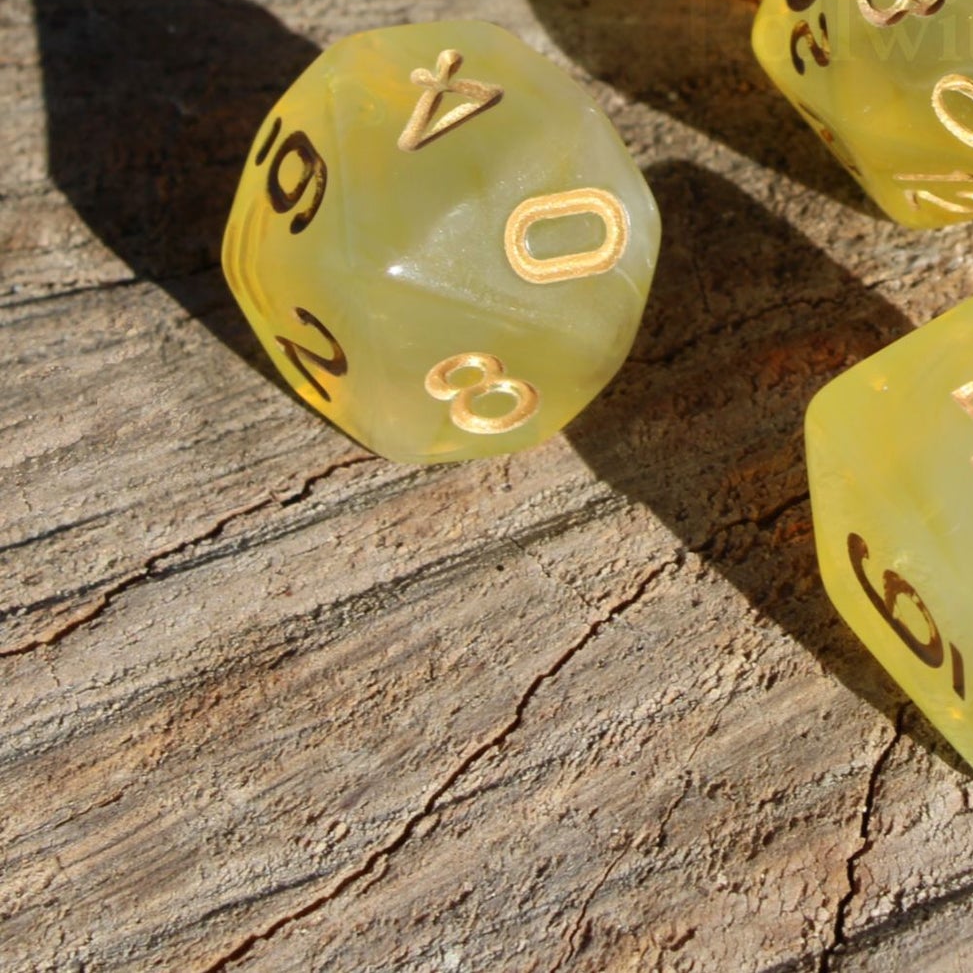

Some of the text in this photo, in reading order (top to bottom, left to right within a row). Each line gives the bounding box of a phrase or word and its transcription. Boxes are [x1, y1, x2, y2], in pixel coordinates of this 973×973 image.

[397, 48, 504, 152] 4
[504, 187, 628, 285] 0
[275, 306, 348, 403] 2
[424, 351, 541, 435] 8
